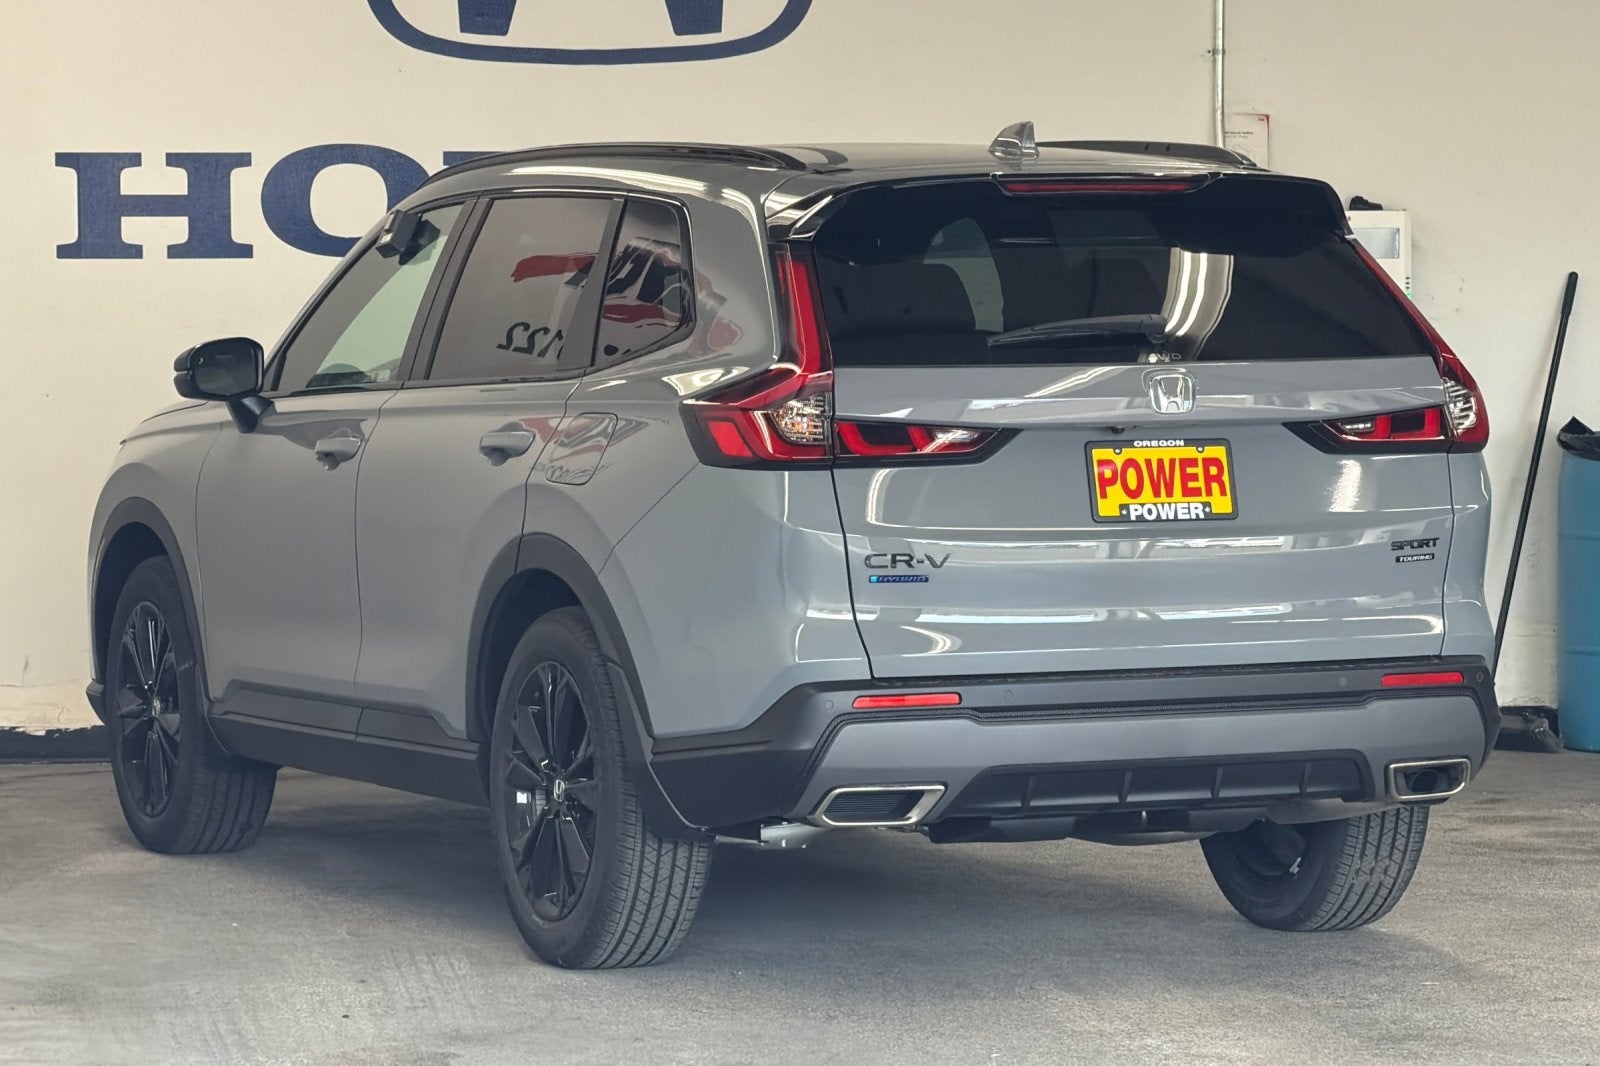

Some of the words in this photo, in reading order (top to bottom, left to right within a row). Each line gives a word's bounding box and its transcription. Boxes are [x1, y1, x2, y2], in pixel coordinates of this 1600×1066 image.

[54, 143, 508, 260] HO
[1133, 439, 1185, 448] OREGON
[1096, 457, 1228, 500] POWER
[1128, 502, 1205, 521] POWER
[1391, 537, 1440, 551] SPORT
[864, 553, 951, 569] CR-V
[1399, 553, 1433, 562] TOURING
